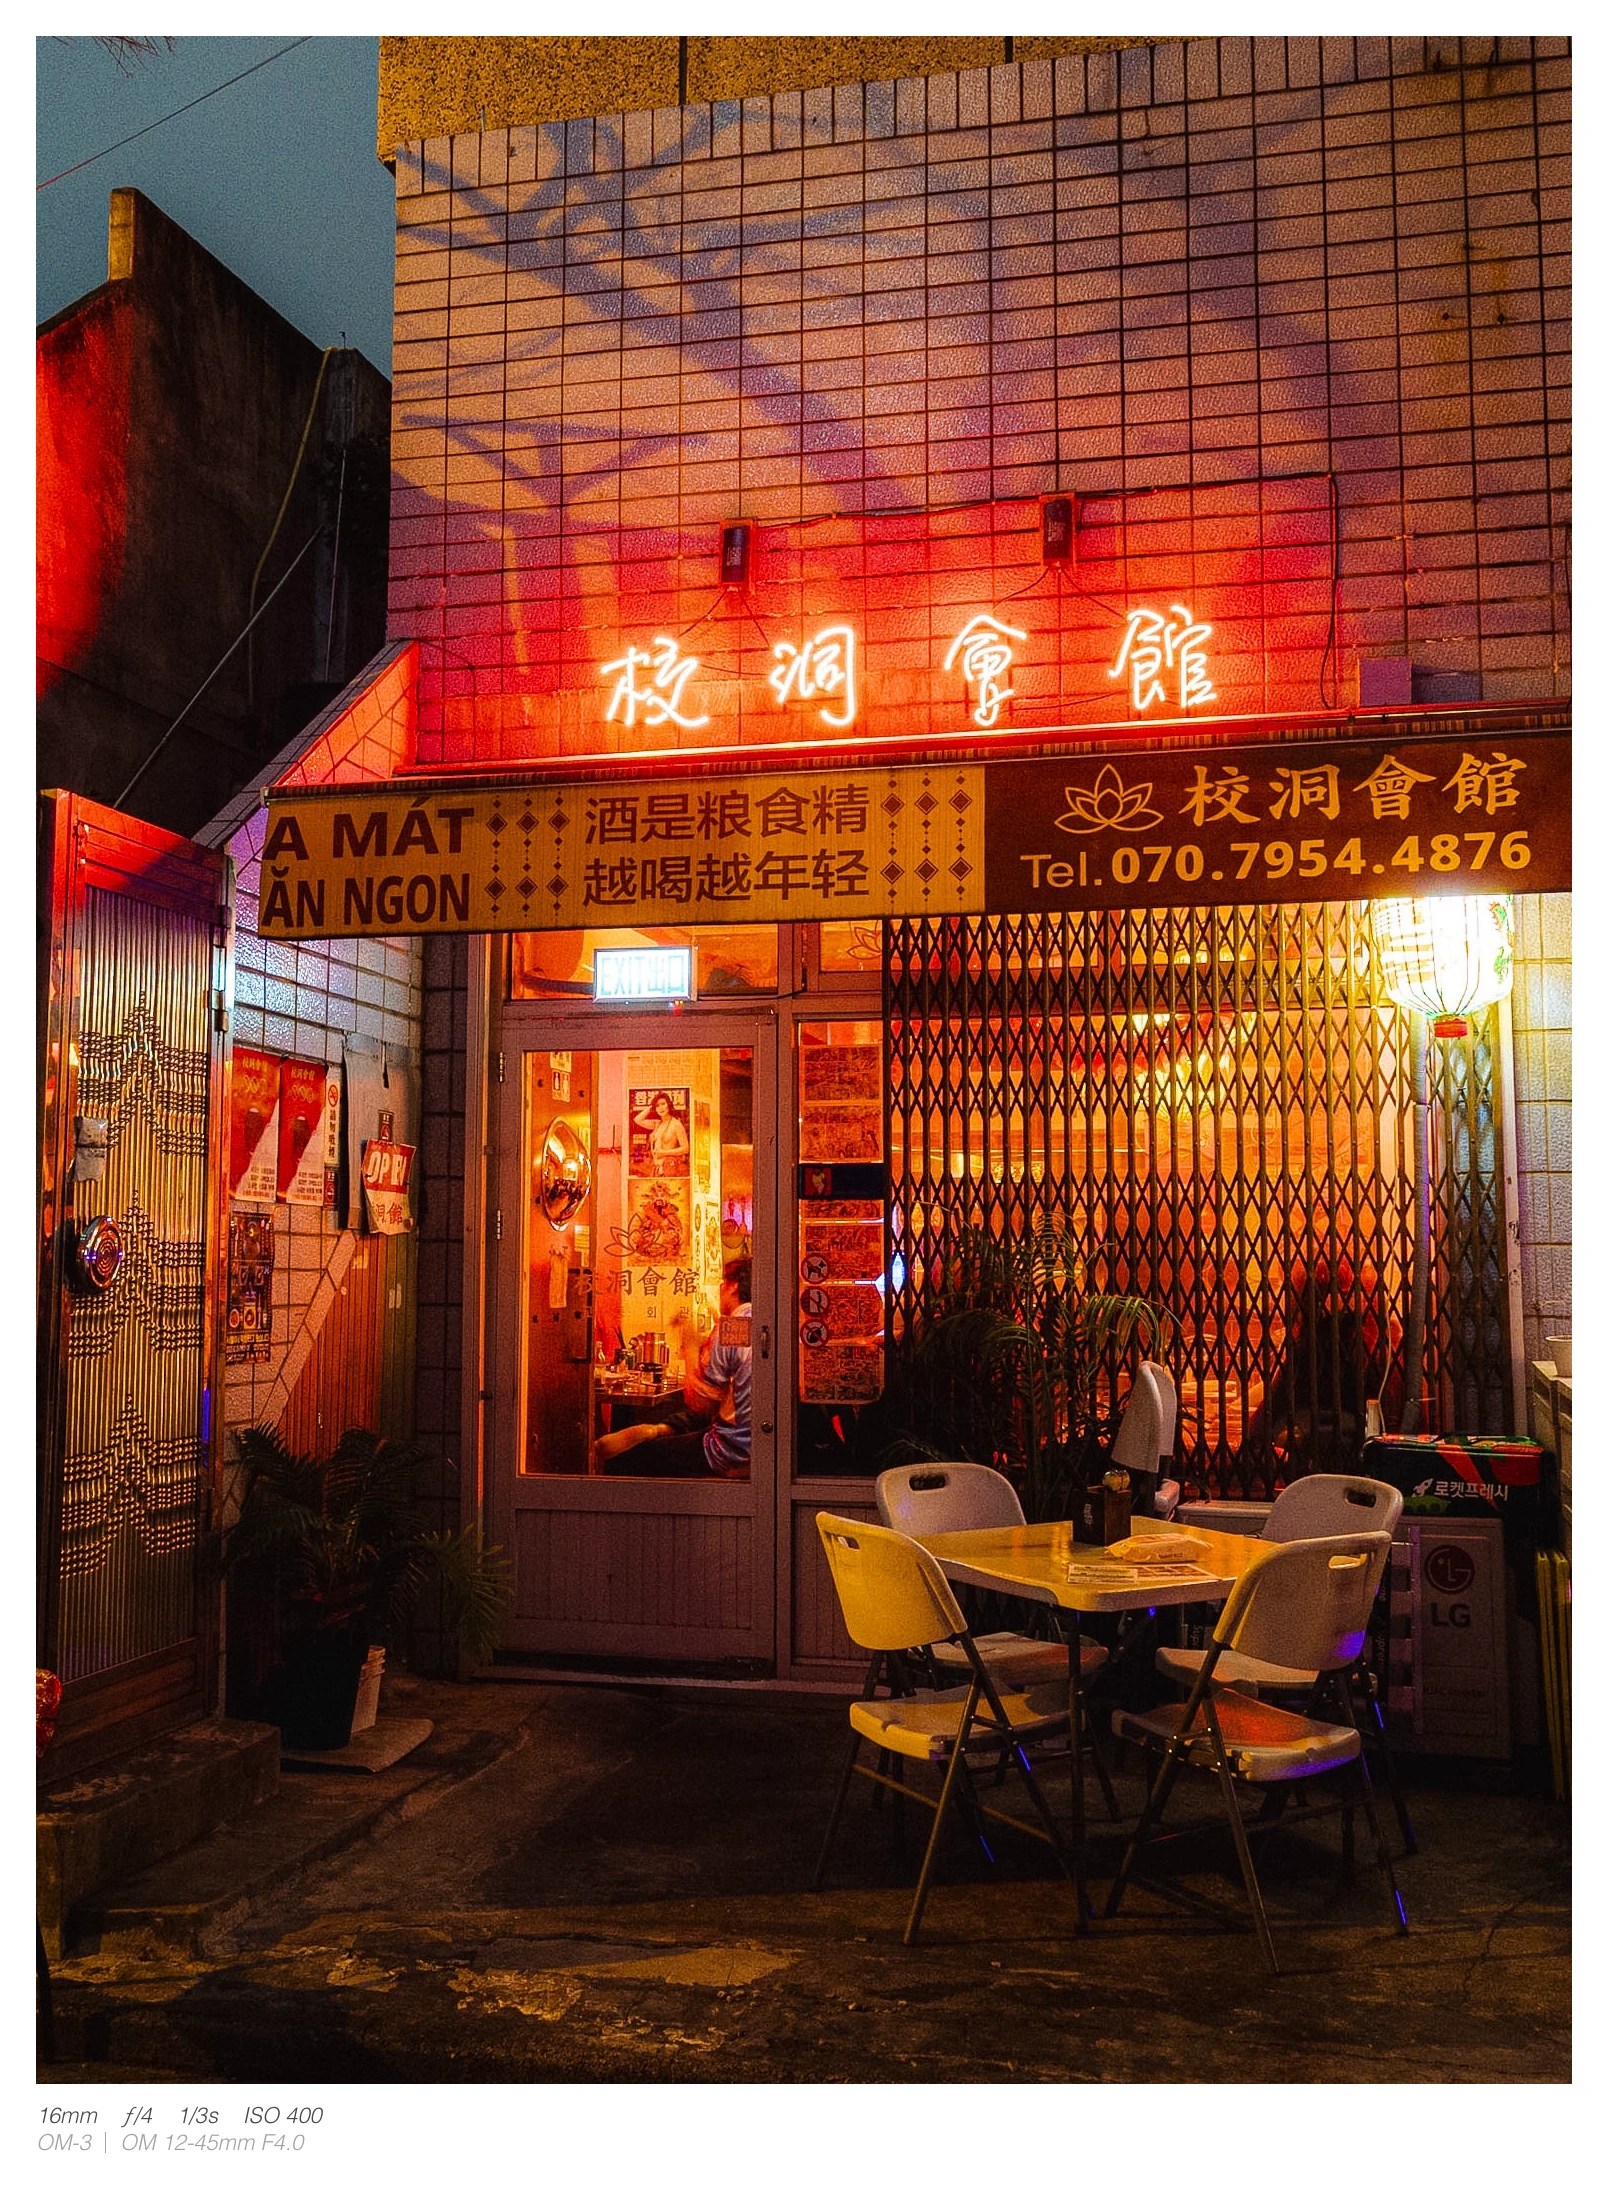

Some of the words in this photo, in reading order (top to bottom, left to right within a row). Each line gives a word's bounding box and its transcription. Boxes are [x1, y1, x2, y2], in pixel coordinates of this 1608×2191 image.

[599, 605, 1218, 728] 校洞會館
[585, 783, 870, 844] 酒是粮食精
[1178, 752, 1528, 828] 校洞會館
[332, 797, 475, 858] MÁT
[261, 865, 325, 928] ĂN
[343, 873, 470, 926] NGON
[583, 848, 869, 907] 越喝越年轻
[1434, 1480, 1509, 1501] 로켓프레시
[1430, 1602, 1471, 1628] LG
